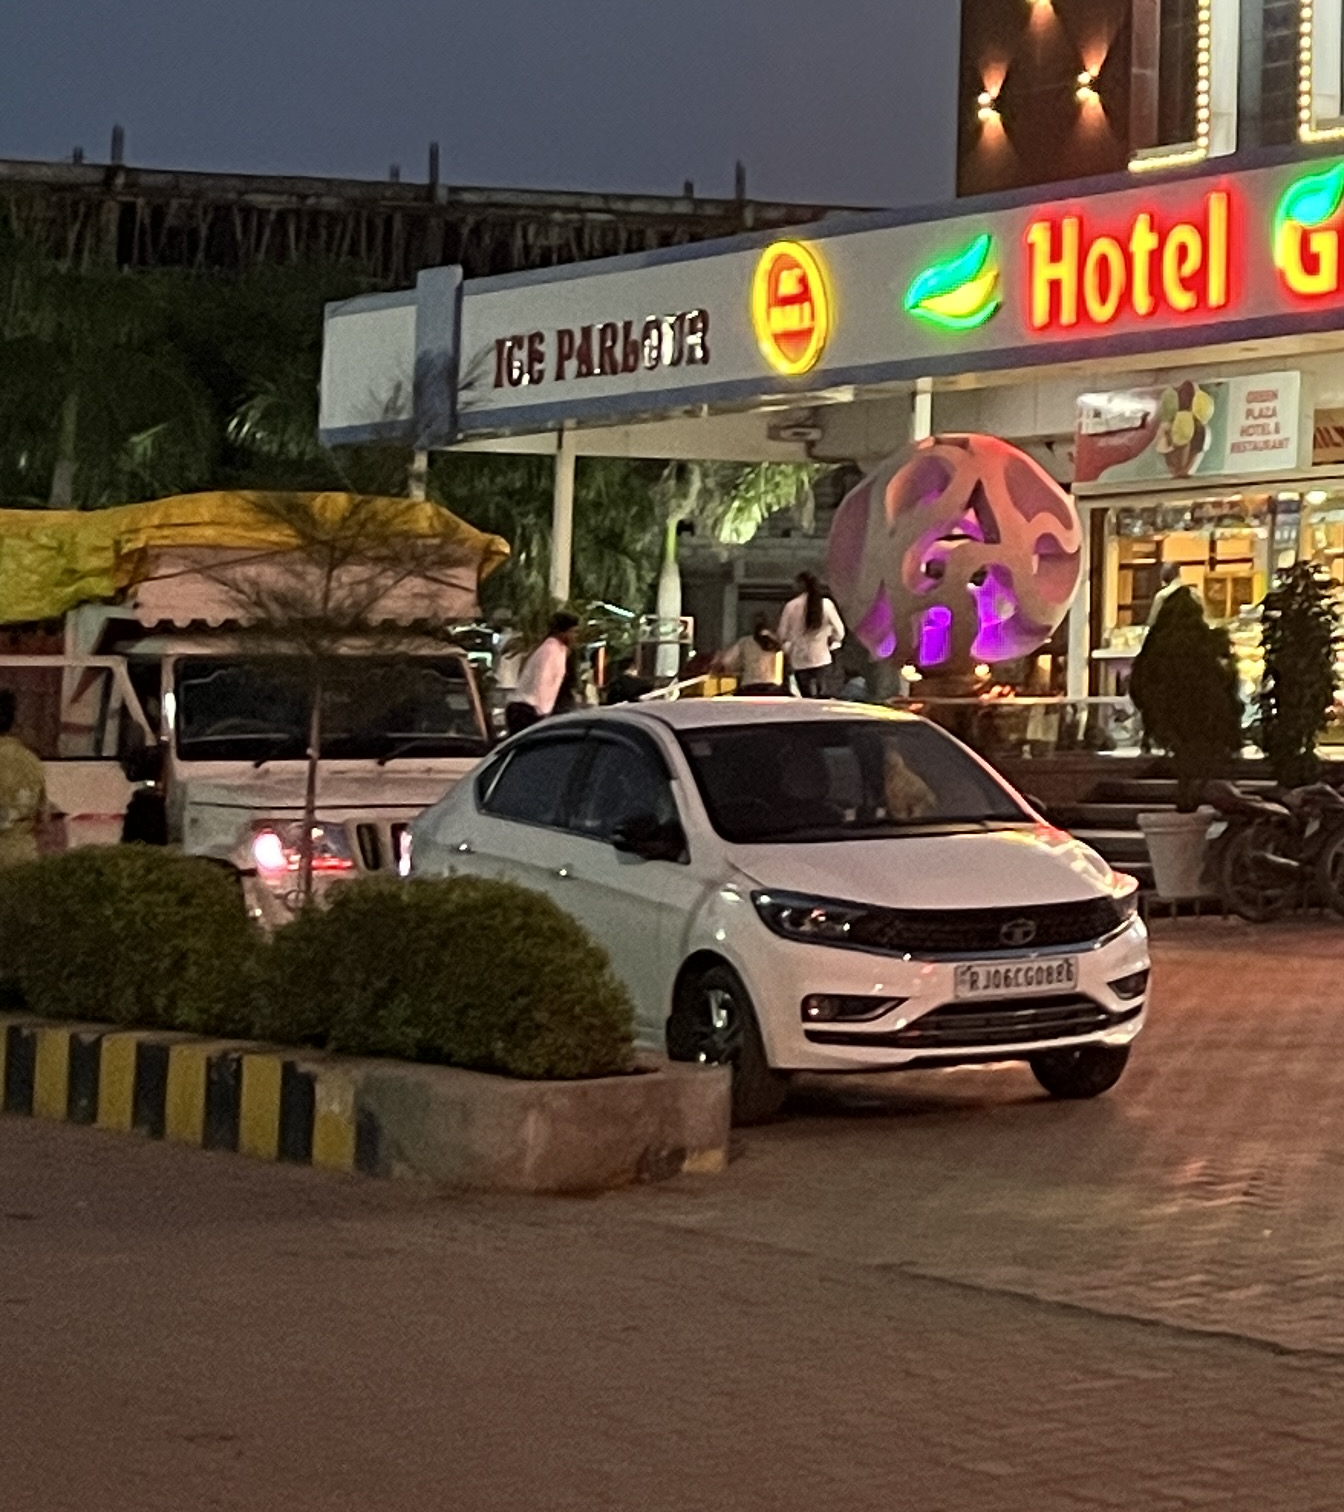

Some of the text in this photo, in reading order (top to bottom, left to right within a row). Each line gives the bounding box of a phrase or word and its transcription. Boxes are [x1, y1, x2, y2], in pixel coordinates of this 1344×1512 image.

[1026, 190, 1229, 330] Hotel
[493, 308, 710, 388] ICE PARLOUR
[1240, 424, 1271, 437] HOTEL
[1245, 406, 1277, 420] PLAZA
